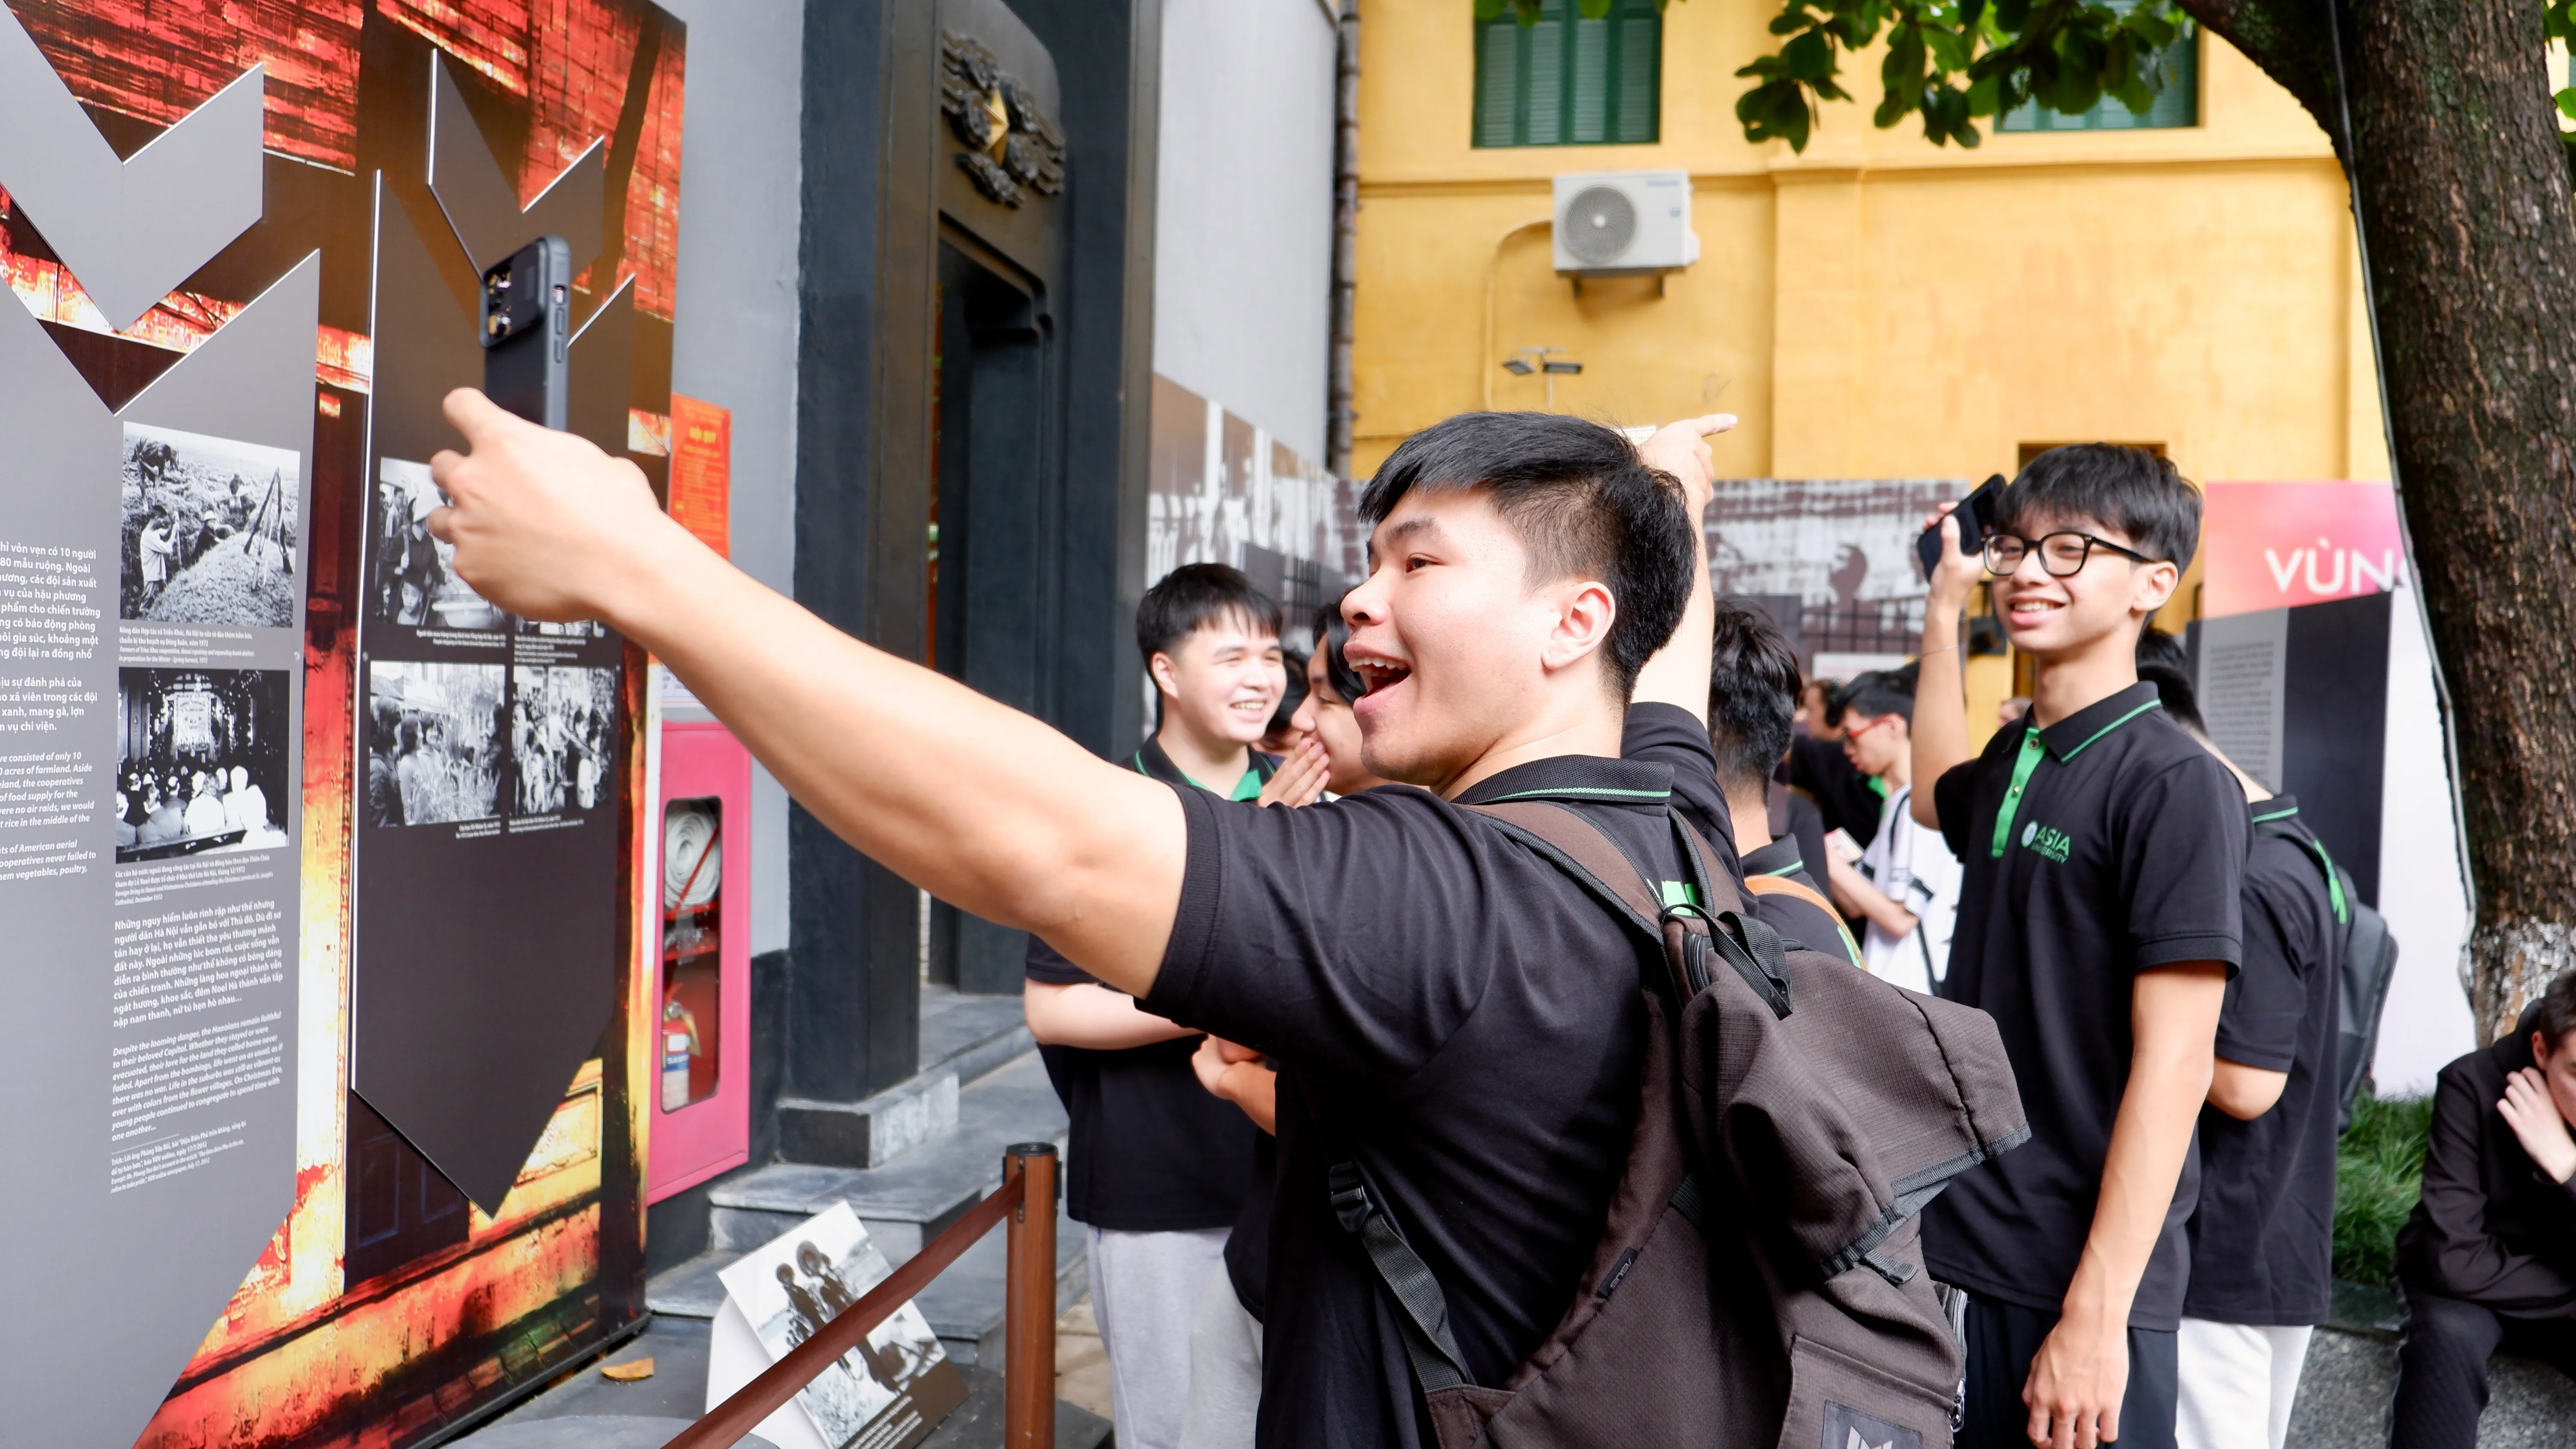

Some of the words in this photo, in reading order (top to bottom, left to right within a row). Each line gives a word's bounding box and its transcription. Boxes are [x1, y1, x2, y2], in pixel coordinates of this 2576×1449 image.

[11, 542, 27, 553] vỏn
[30, 546, 46, 557] vẹn
[48, 546, 58, 556] có
[60, 547, 70, 557] 10
[72, 549, 96, 561] người
[0, 557, 11, 567] 80
[36, 560, 64, 573] ruộng.
[66, 562, 90, 574] Ngoài
[30, 574, 44, 584] các
[46, 575, 60, 588] đội
[62, 576, 76, 586] sản
[79, 576, 97, 588] xuất
[17, 587, 33, 598] của
[35, 588, 51, 601] hậu
[53, 590, 86, 604] phương
[1, 601, 27, 614] phẩm
[29, 603, 45, 613] cho
[47, 604, 70, 615] chiến
[72, 606, 100, 619] trường
[13, 617, 23, 627] có
[25, 617, 42, 628] báo
[44, 618, 67, 631] động
[69, 620, 95, 633] phòng
[13, 632, 27, 644] gia
[29, 633, 46, 644] súc,
[48, 633, 80, 646] khoảng
[82, 635, 98, 647] một
[12, 647, 26, 659] đội
[28, 647, 39, 660] lại
[52, 647, 74, 661] đồng
[12, 678, 23, 689] sự
[24, 677, 47, 687] đánh
[49, 677, 65, 689] phá
[67, 676, 82, 687] của
[9, 692, 20, 701] xã
[22, 692, 41, 701] viên
[43, 693, 67, 704] trong
[69, 692, 82, 701] các
[84, 691, 97, 704] đội
[2, 706, 27, 717] xanh,
[29, 709, 54, 718] mang
[56, 706, 69, 718] gà,
[71, 706, 84, 718] lợn
[21, 721, 33, 731] chi
[36, 721, 57, 733] viện.
[9, 752, 45, 762] consisted
[46, 752, 55, 761] of
[55, 751, 71, 762] only
[73, 752, 82, 760] 10
[26, 765, 35, 774] of
[35, 764, 72, 774] farmland.
[73, 763, 92, 772] Aside
[23, 779, 36, 788] the
[36, 776, 83, 788] cooperatives
[0, 793, 8, 802] of
[9, 791, 27, 801] food
[27, 790, 53, 802] supply
[54, 790, 65, 799] for
[66, 789, 78, 798] the
[27, 804, 38, 813] air
[39, 803, 59, 812] raids,
[73, 800, 94, 810] would
[5, 818, 19, 828] rice
[20, 818, 28, 827] in
[29, 817, 42, 826] the
[43, 815, 69, 825] middle
[69, 814, 78, 823] of
[78, 813, 90, 822] the
[9, 844, 19, 853] of
[18, 842, 55, 852] American
[56, 839, 78, 849] aerial
[2035, 826, 2070, 857] ASIA
[45, 855, 67, 863] never
[67, 850, 88, 861] failed
[16, 867, 58, 880] vegetables,
[1610, 1258, 1631, 1288] ASUS
